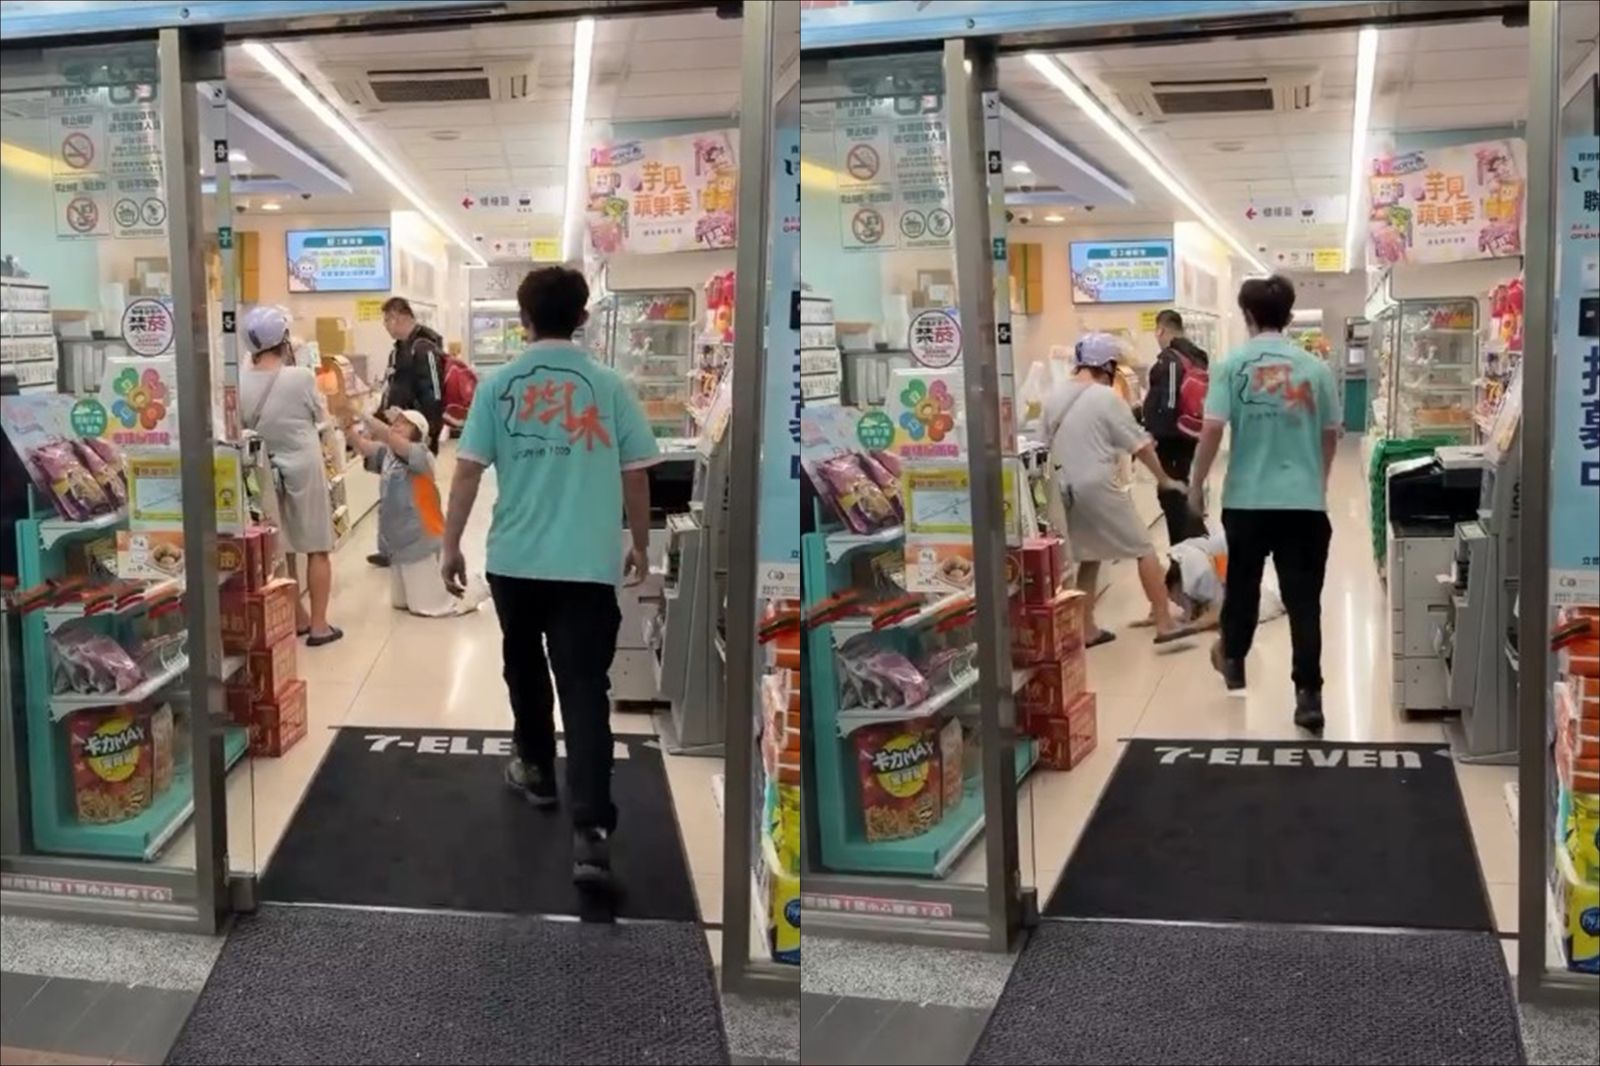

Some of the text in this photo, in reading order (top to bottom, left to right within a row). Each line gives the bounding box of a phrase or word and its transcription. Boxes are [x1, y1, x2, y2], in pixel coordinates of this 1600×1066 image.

[641, 161, 686, 193] 芋見
[1424, 169, 1470, 202] 芋見
[632, 190, 692, 218] 蔬果季
[1416, 201, 1475, 227] 蔬果季
[364, 734, 630, 760] 7-ELE
